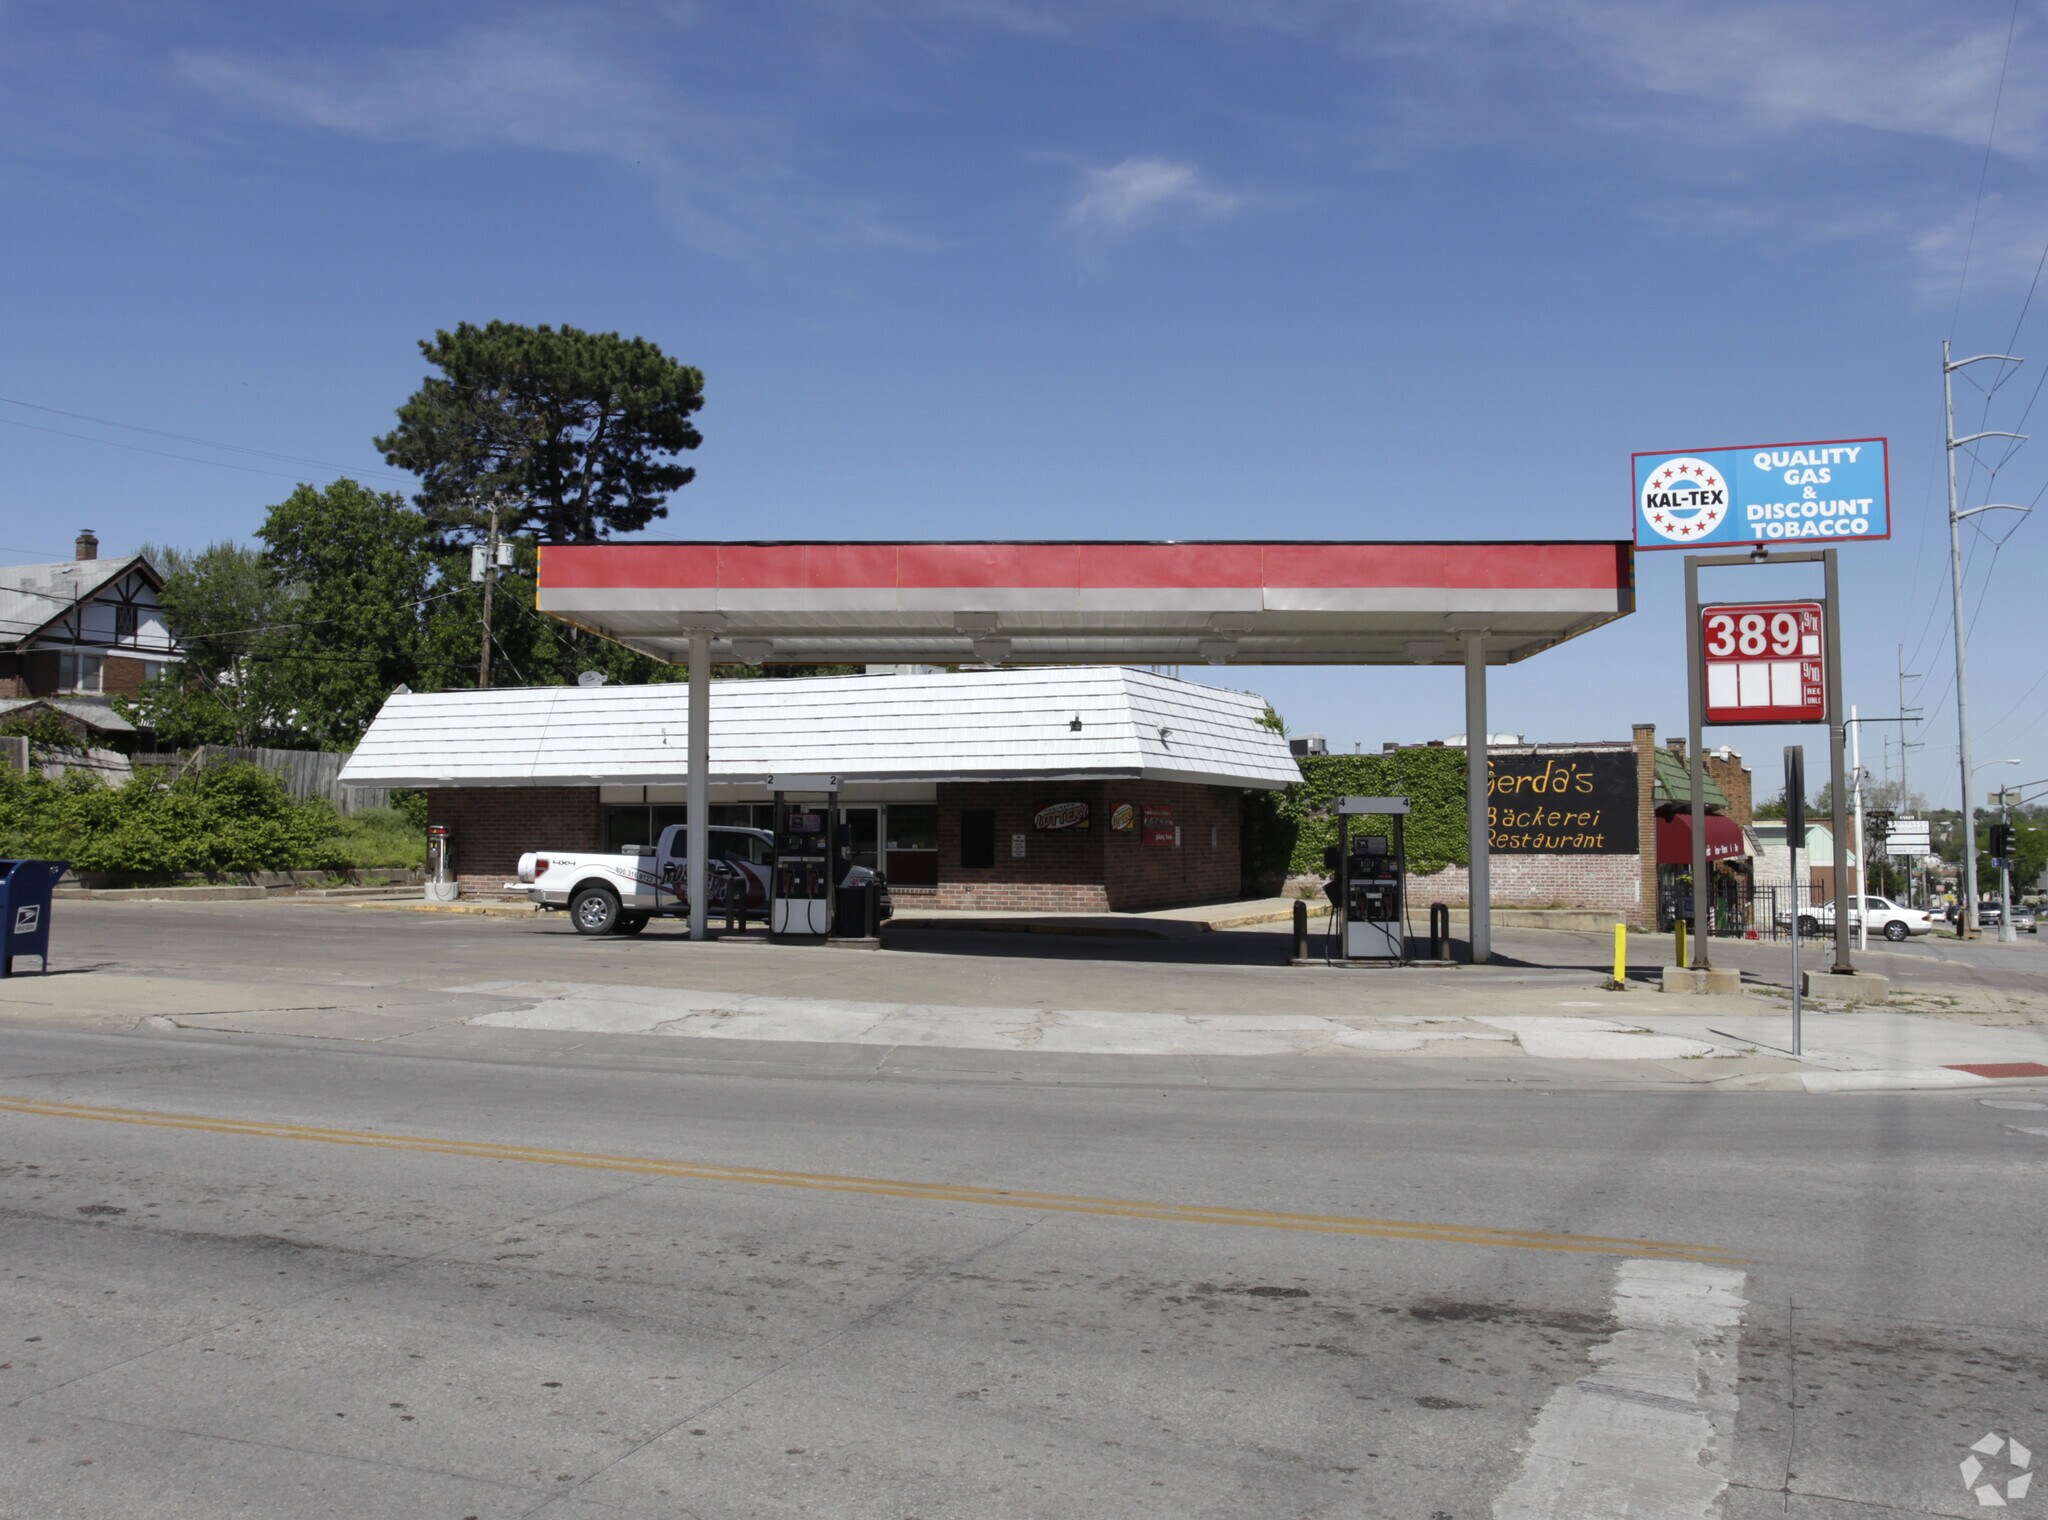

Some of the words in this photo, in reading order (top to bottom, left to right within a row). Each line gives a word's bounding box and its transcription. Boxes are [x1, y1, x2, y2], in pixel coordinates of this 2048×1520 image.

[1753, 447, 1862, 471] QUALITY
[1784, 468, 1831, 485] GAS
[1646, 490, 1724, 508] KAL-TEX
[1802, 486, 1818, 499] &
[1747, 499, 1873, 521] DISCOUNT
[1751, 518, 1869, 538] TOBACCO
[1708, 613, 1799, 656] 389
[767, 775, 774, 784] 2
[830, 776, 837, 785] 2
[1339, 798, 1346, 807] 4
[1402, 798, 1409, 807] 4
[1035, 805, 1089, 829] LOTTERY
[1487, 806, 1602, 828] Bäckerei
[1488, 829, 1605, 849] Restaurant
